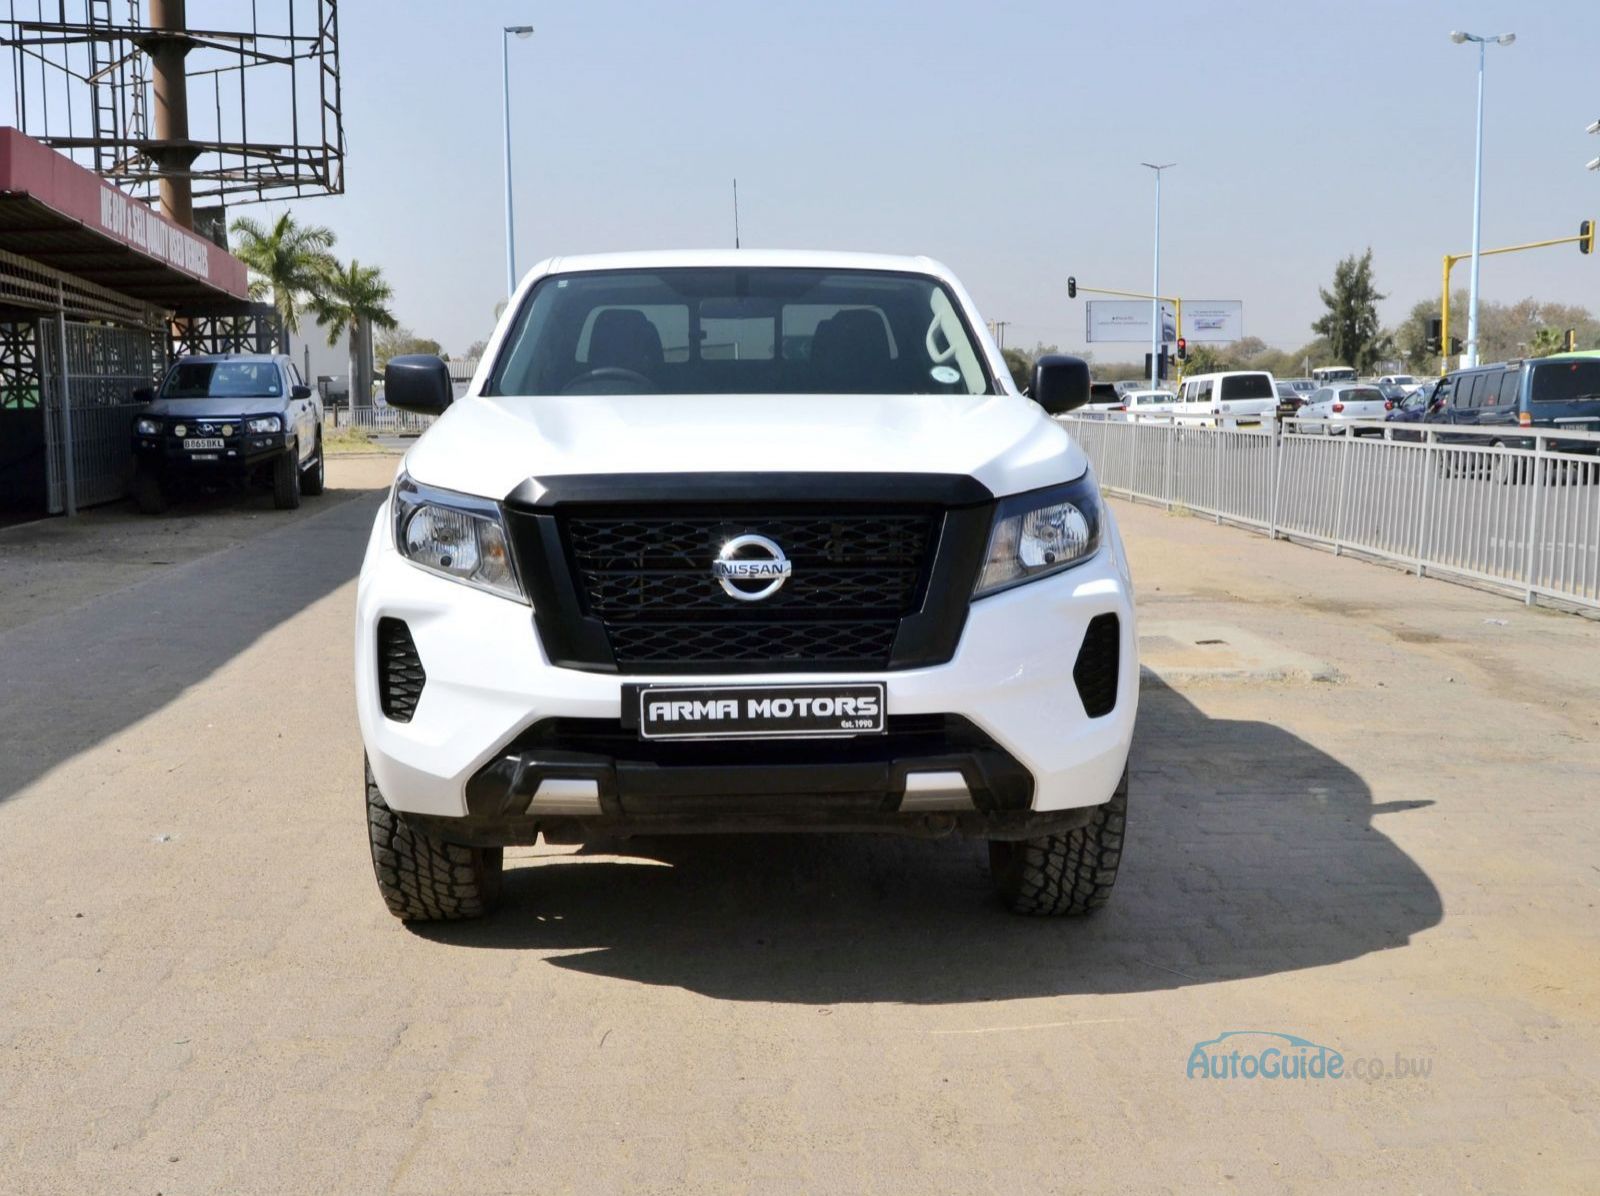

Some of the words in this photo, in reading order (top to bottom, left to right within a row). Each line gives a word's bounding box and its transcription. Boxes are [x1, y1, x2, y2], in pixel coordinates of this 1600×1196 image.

[100, 185, 113, 230] WE
[112, 191, 127, 237] BUY
[132, 203, 147, 249] SELL
[721, 564, 783, 575] NISSAN
[649, 700, 739, 721] ARMA
[747, 697, 879, 718] MOTORS
[855, 720, 873, 728] 1990
